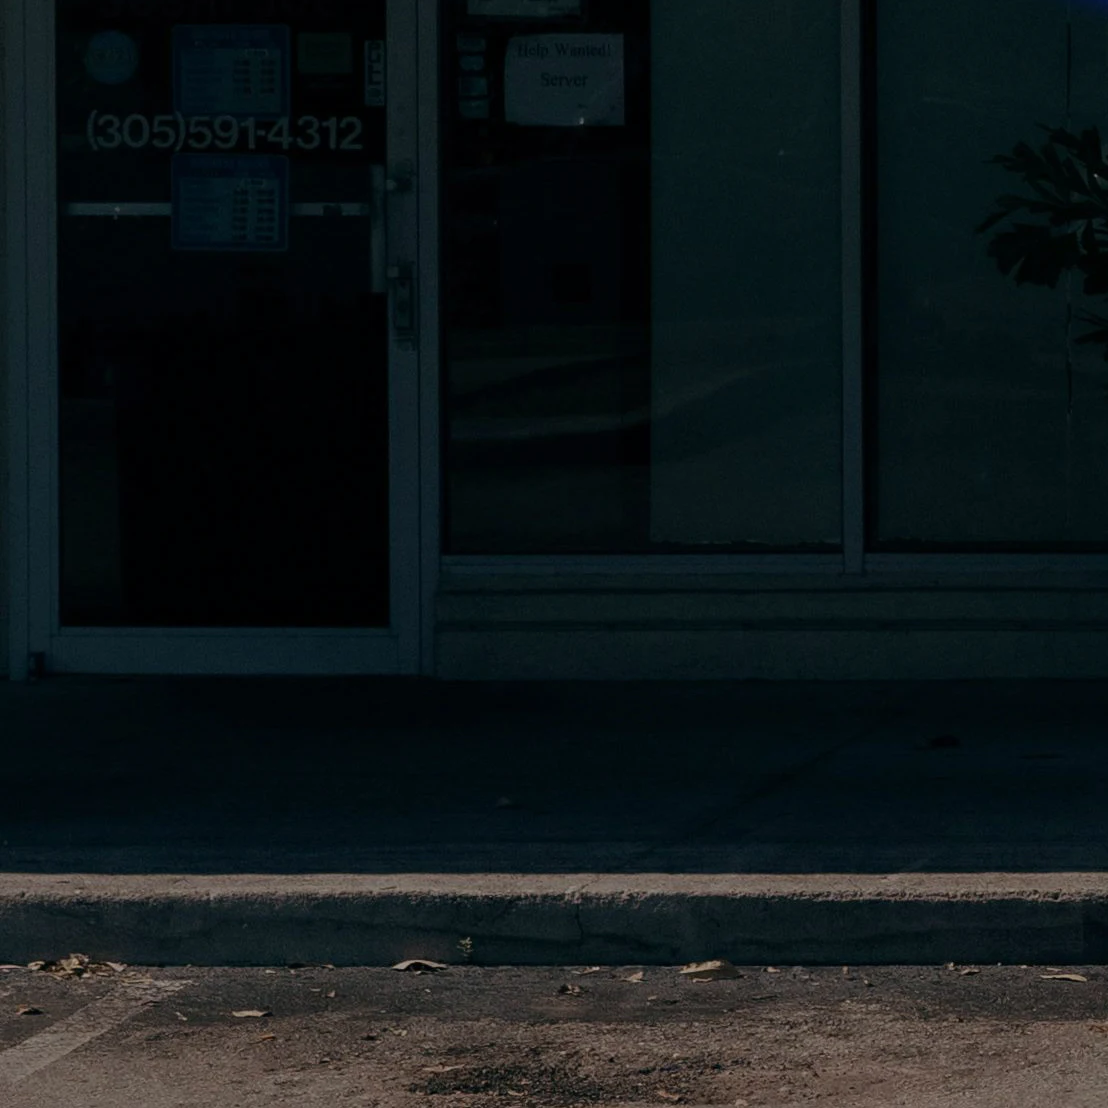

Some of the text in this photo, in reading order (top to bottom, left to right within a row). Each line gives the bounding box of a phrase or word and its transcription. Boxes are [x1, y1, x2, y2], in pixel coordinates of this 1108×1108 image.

[518, 43, 611, 59] Help Wanted!
[541, 72, 588, 87] Server
[86, 109, 364, 152] (305)591-4312
